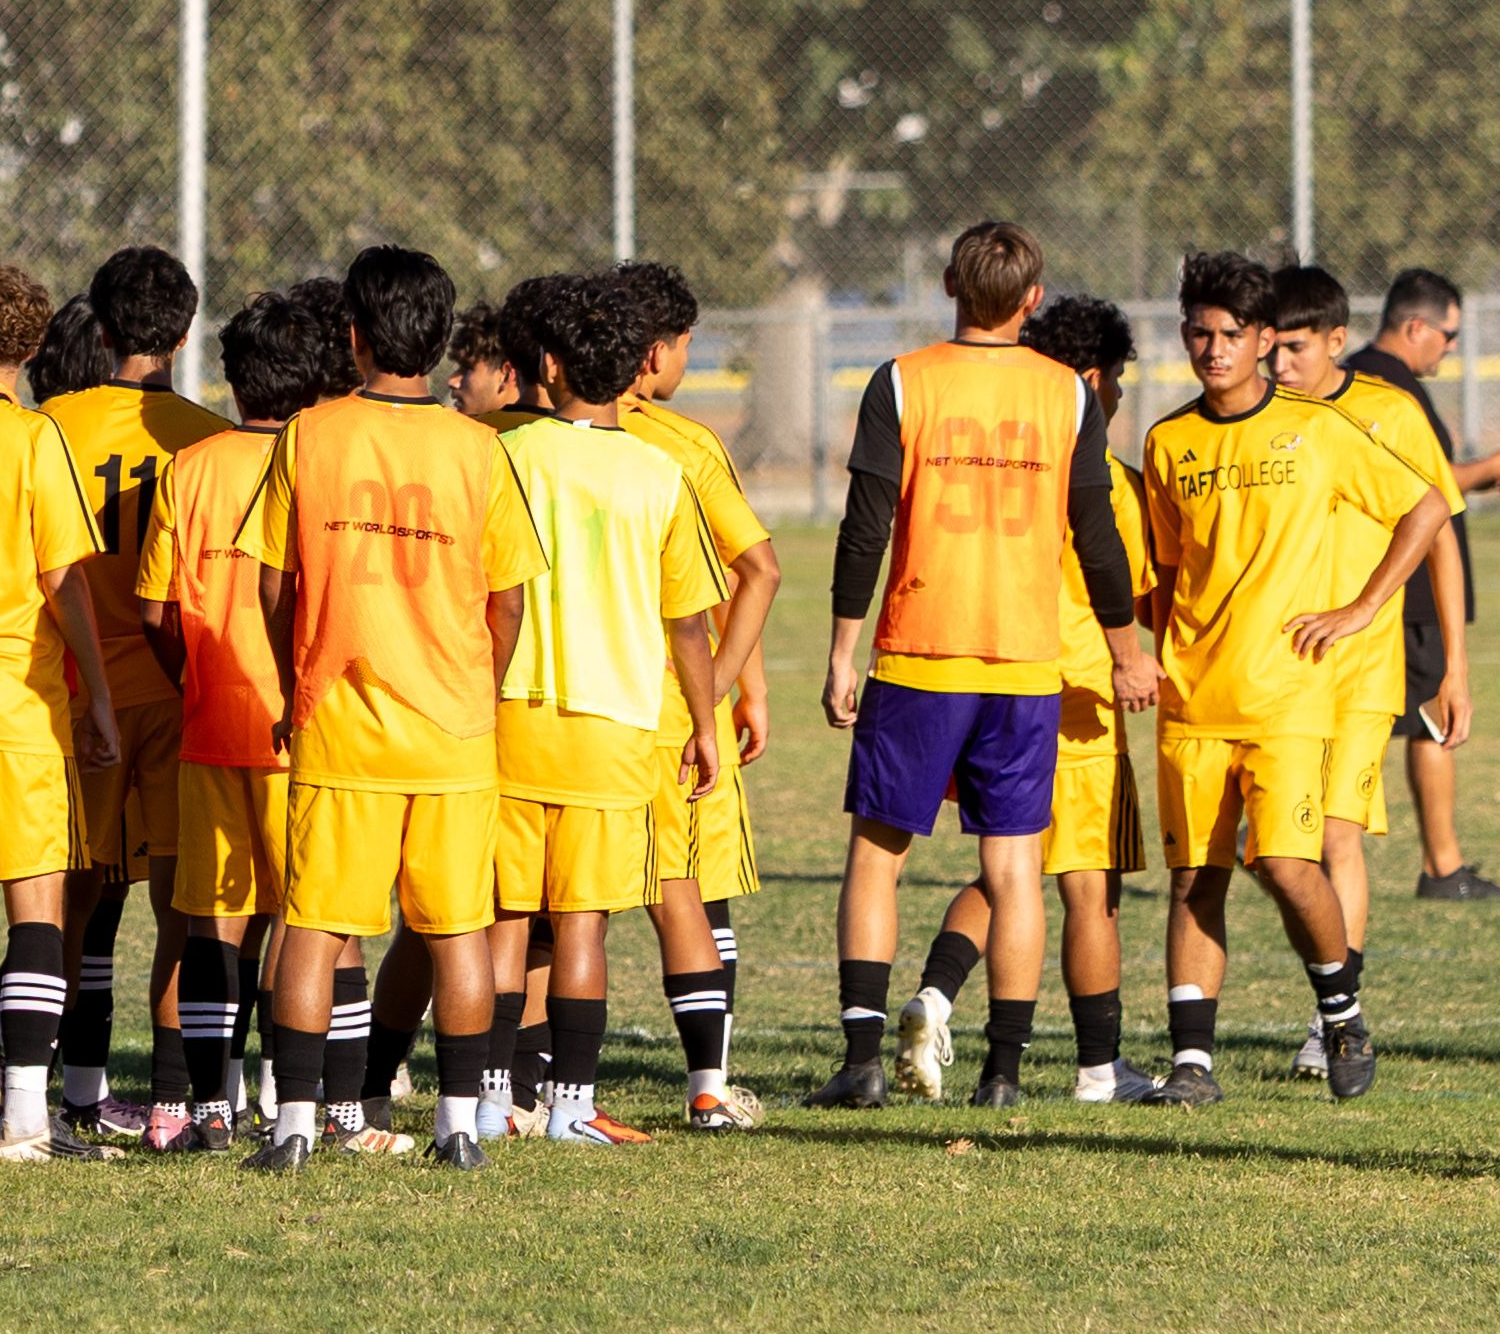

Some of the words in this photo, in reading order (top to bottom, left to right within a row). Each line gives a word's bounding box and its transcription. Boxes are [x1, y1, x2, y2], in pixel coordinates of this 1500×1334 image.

[924, 456, 951, 467] NET
[953, 456, 994, 467] WORLD
[995, 458, 1043, 472] SPORTS
[94, 453, 160, 555] 11
[323, 521, 350, 532] NET
[352, 521, 396, 535] WORLD
[397, 527, 449, 545] SPORTS
